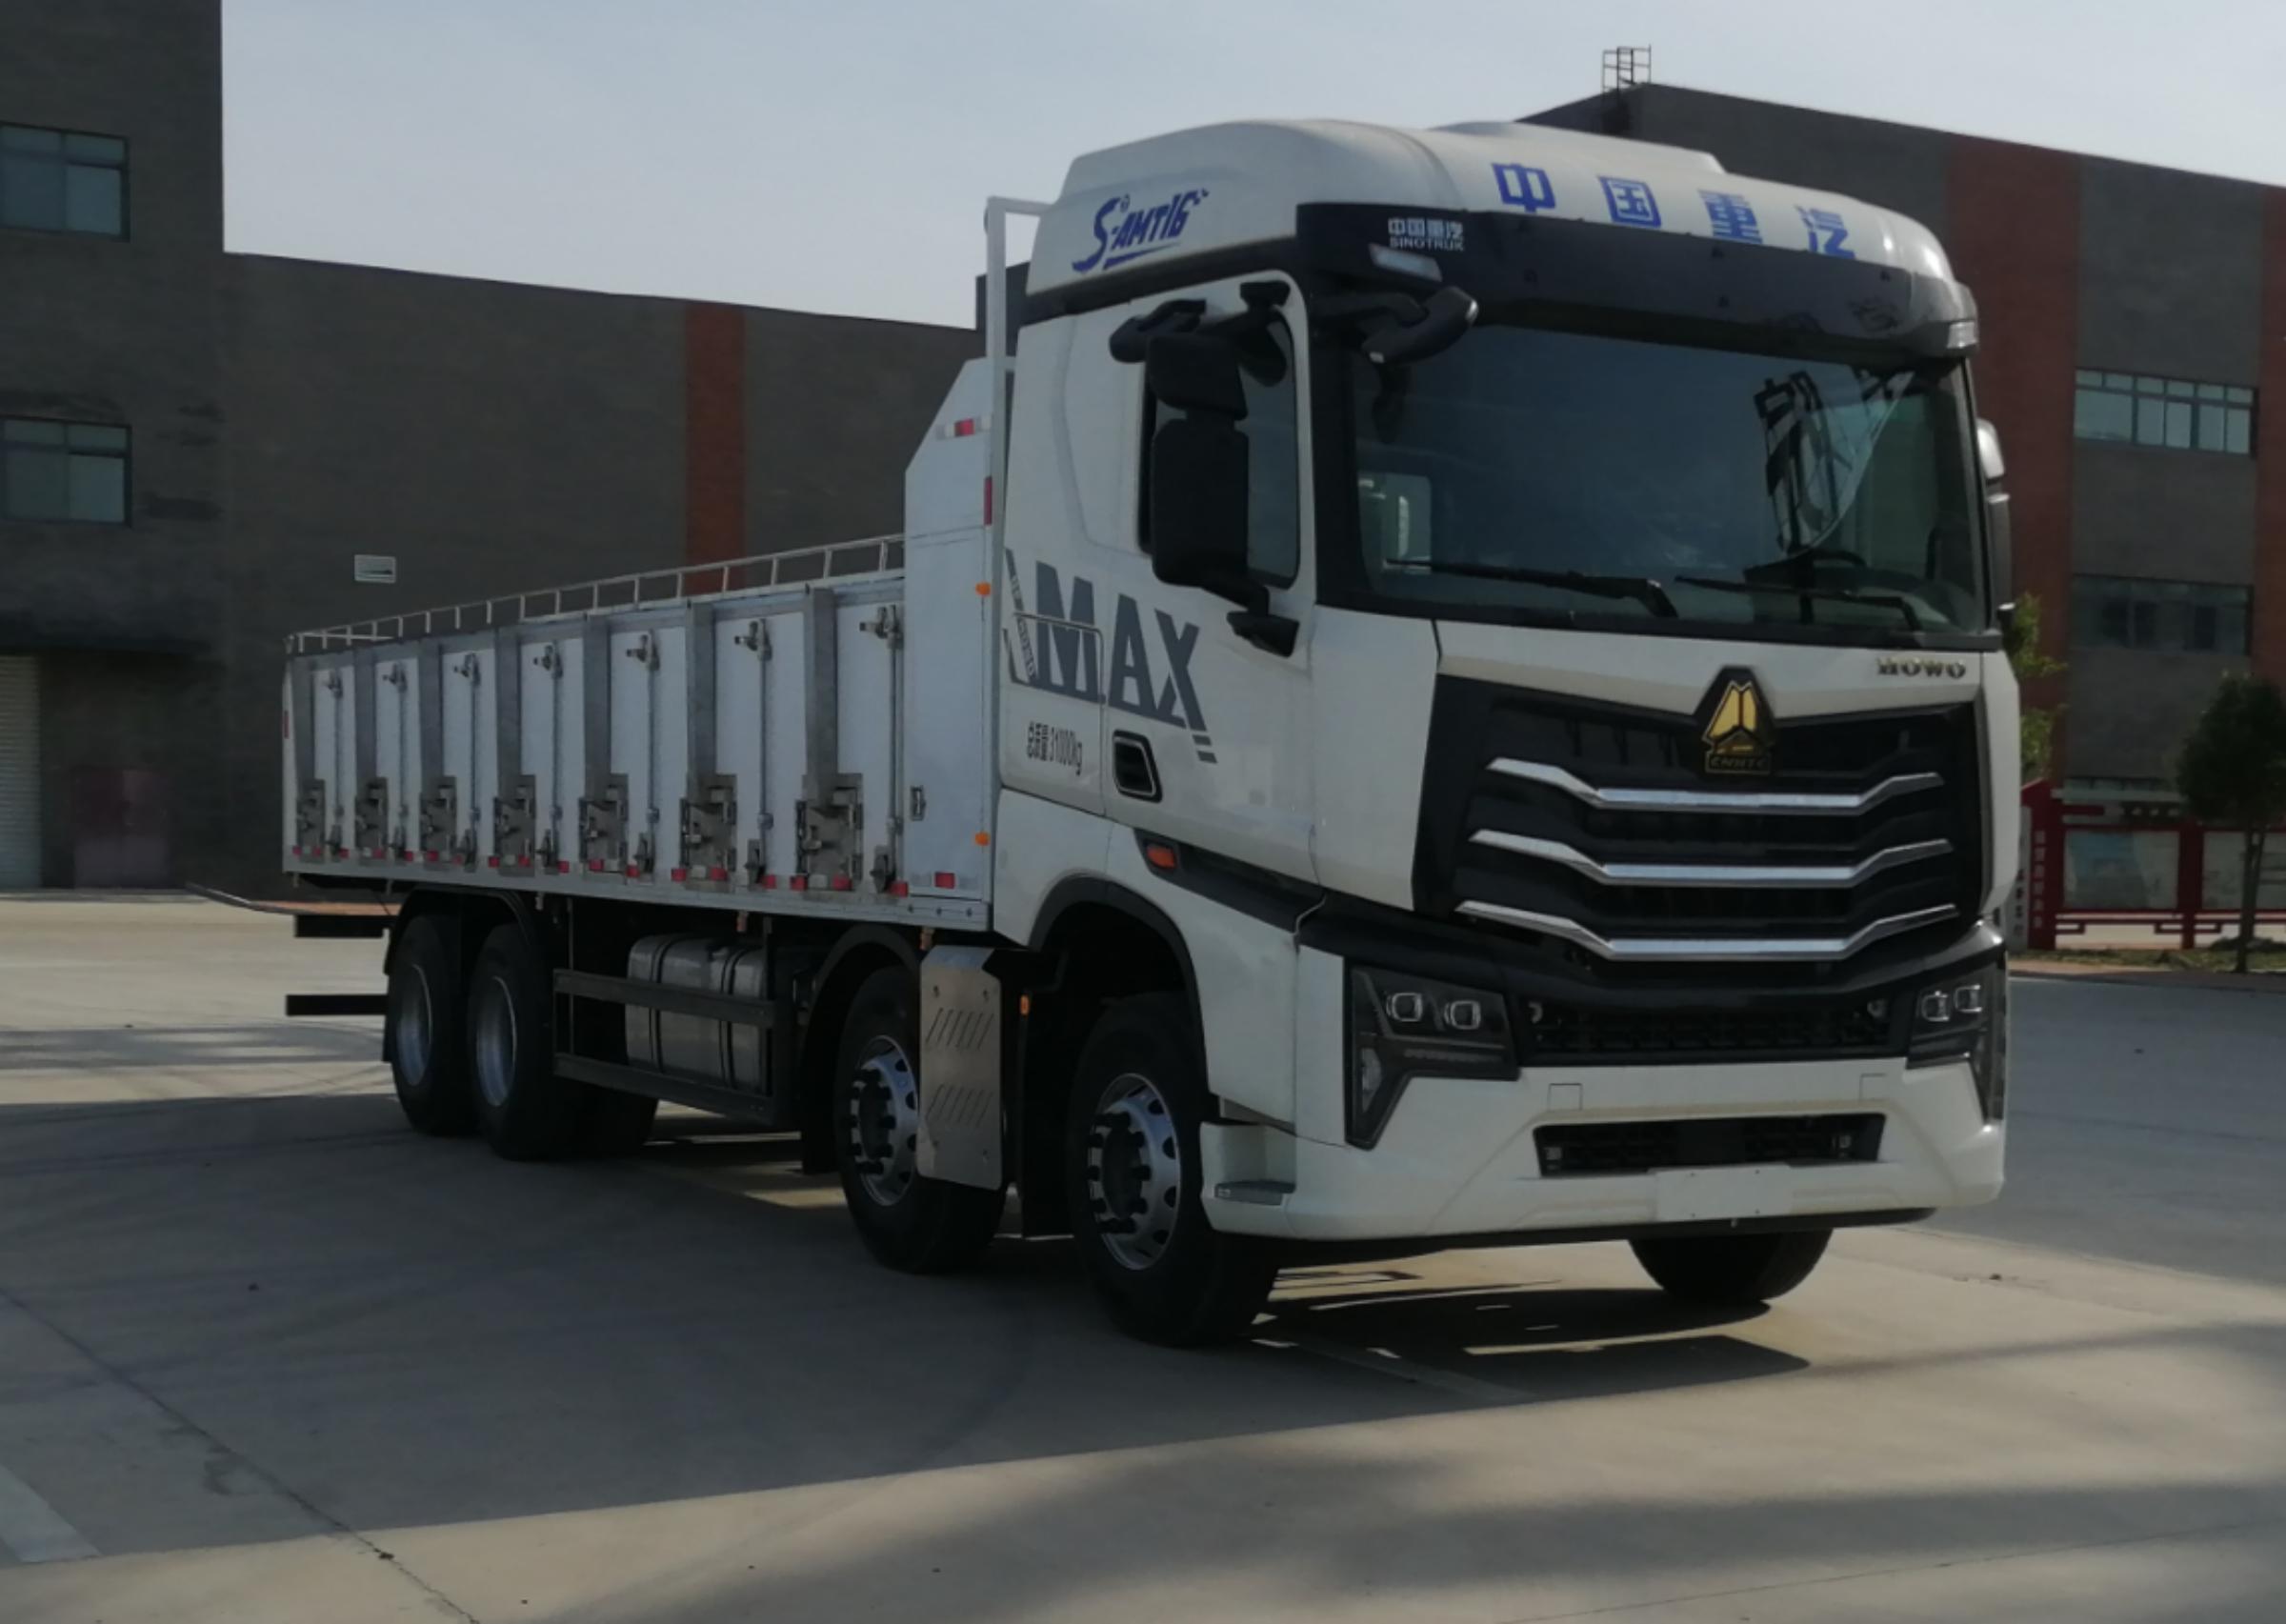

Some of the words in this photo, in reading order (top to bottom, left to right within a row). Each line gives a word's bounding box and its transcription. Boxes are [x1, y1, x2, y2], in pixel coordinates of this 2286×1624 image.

[1493, 162, 1856, 259] 中国重汽
[1390, 236, 1465, 251] SINOTRUK
[1875, 657, 1967, 679] HOWO
